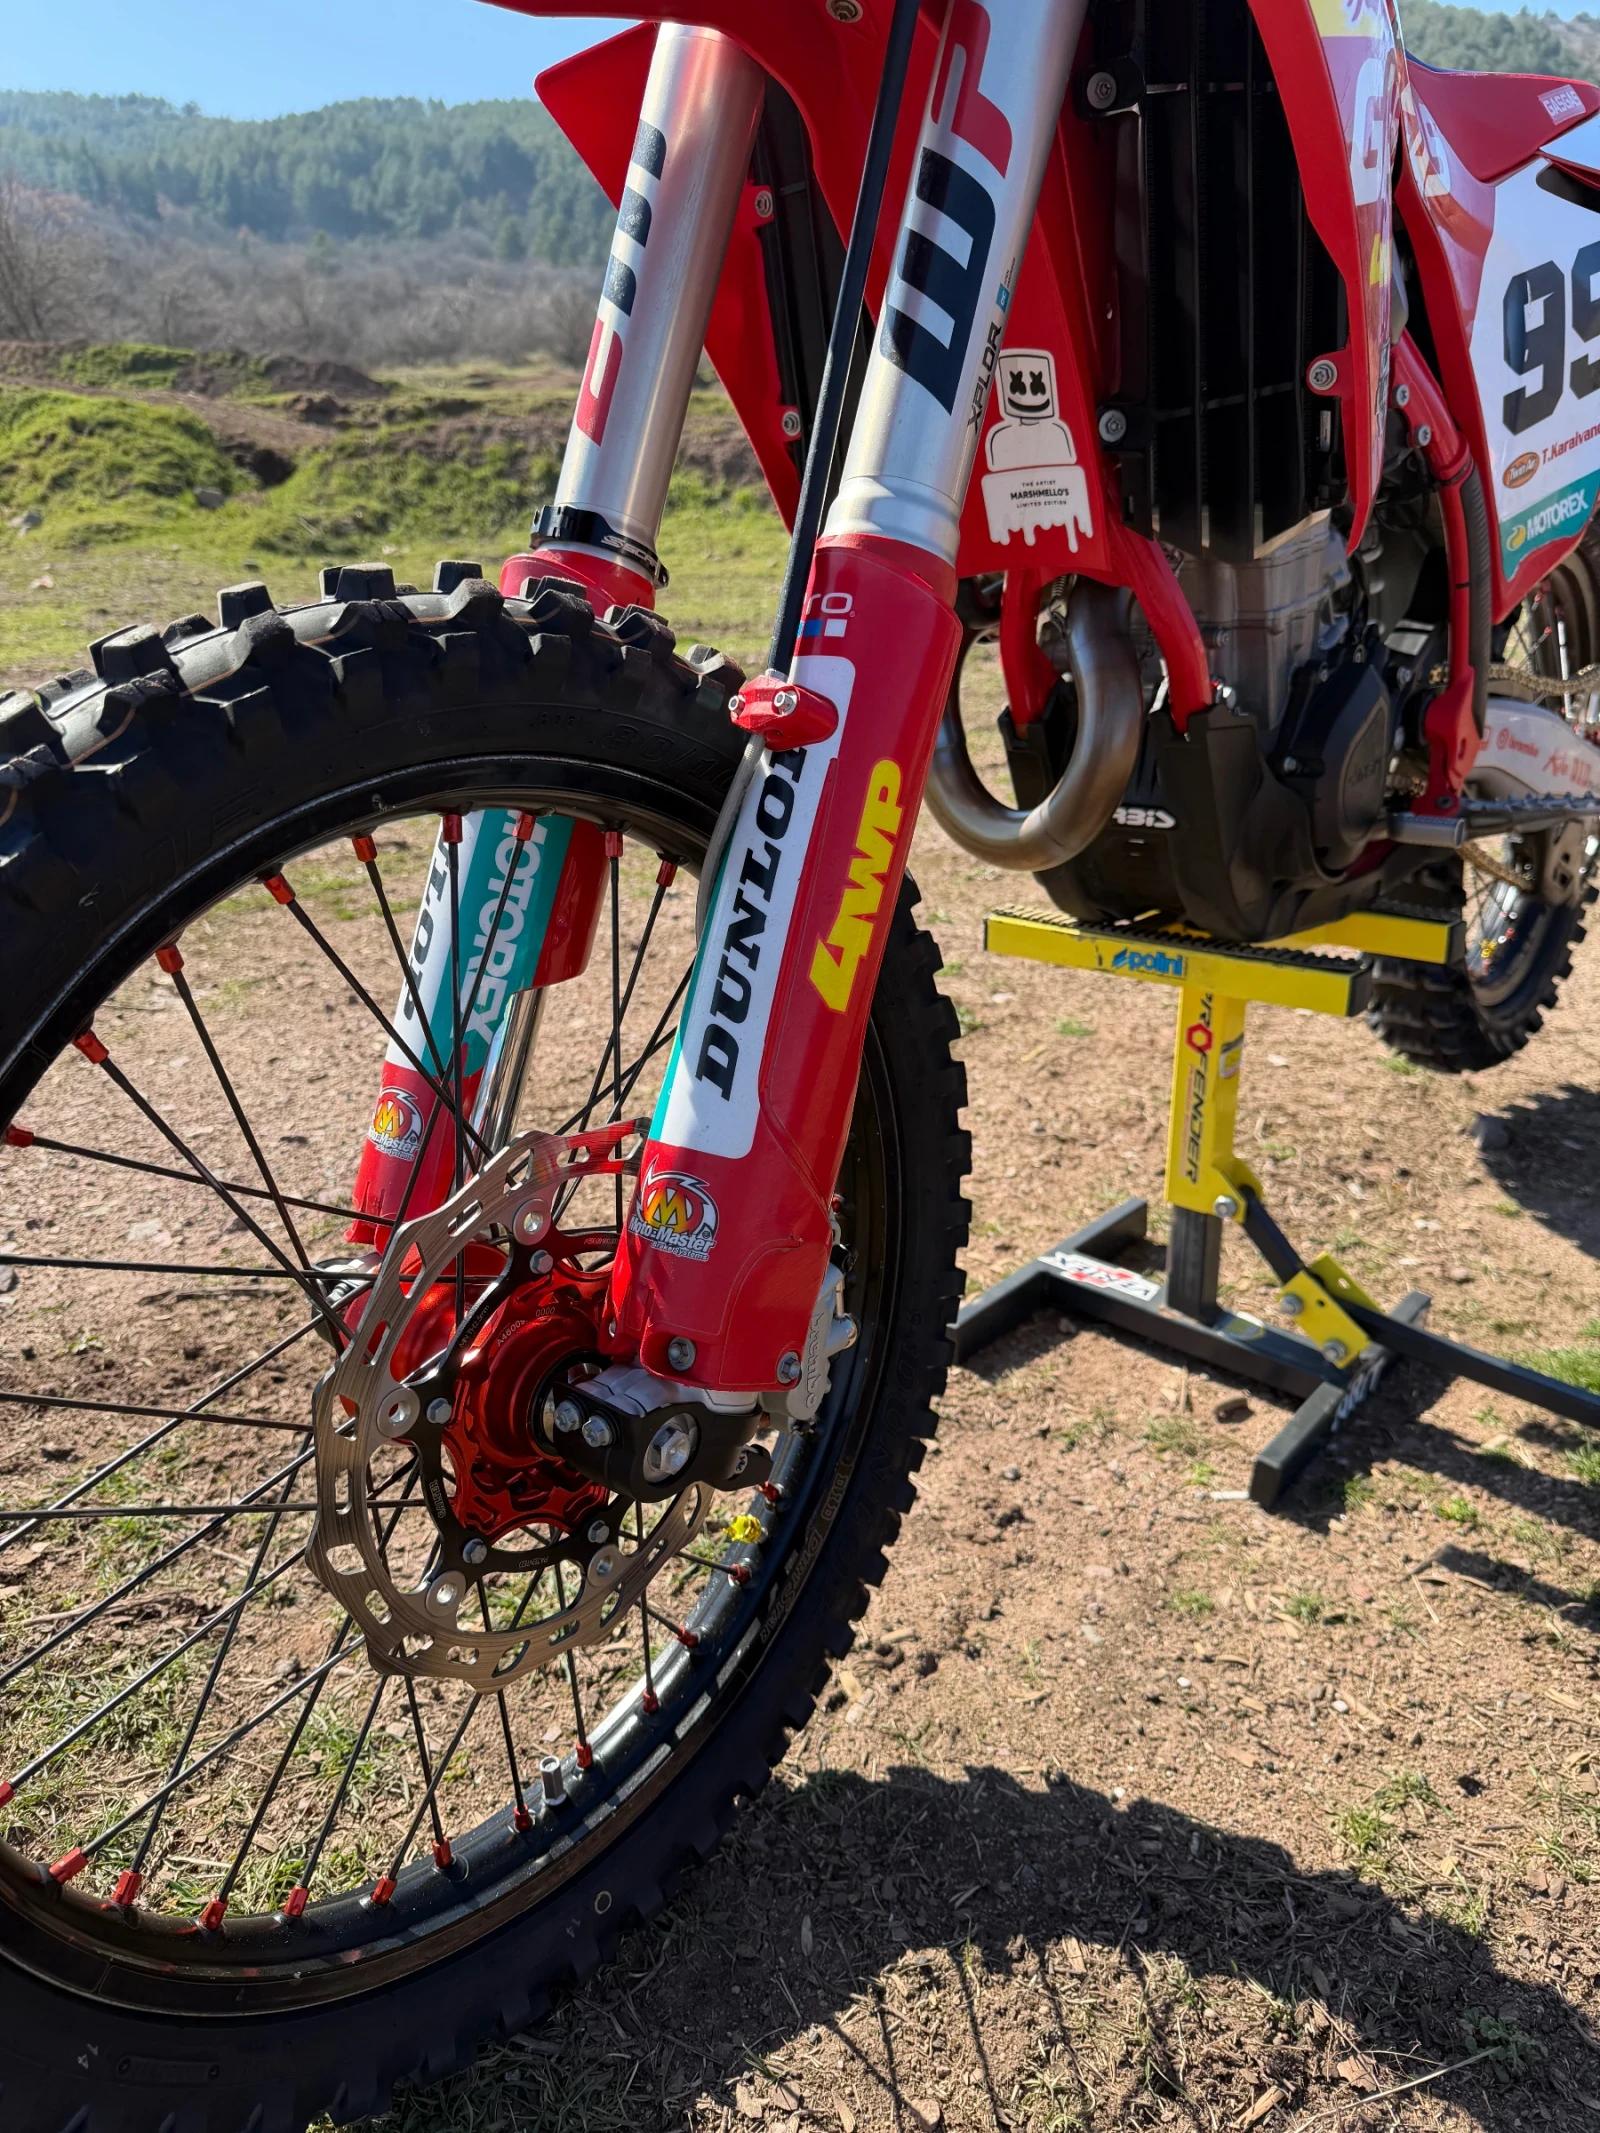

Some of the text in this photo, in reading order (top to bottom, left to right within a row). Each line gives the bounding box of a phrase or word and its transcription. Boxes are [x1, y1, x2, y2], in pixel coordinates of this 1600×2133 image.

[967, 322, 1002, 434] XPLOR
[1010, 488, 1069, 500] MARSHMELLO'S
[1016, 501, 1041, 509] LIMITED
[1526, 489, 1588, 541] MOTOREX
